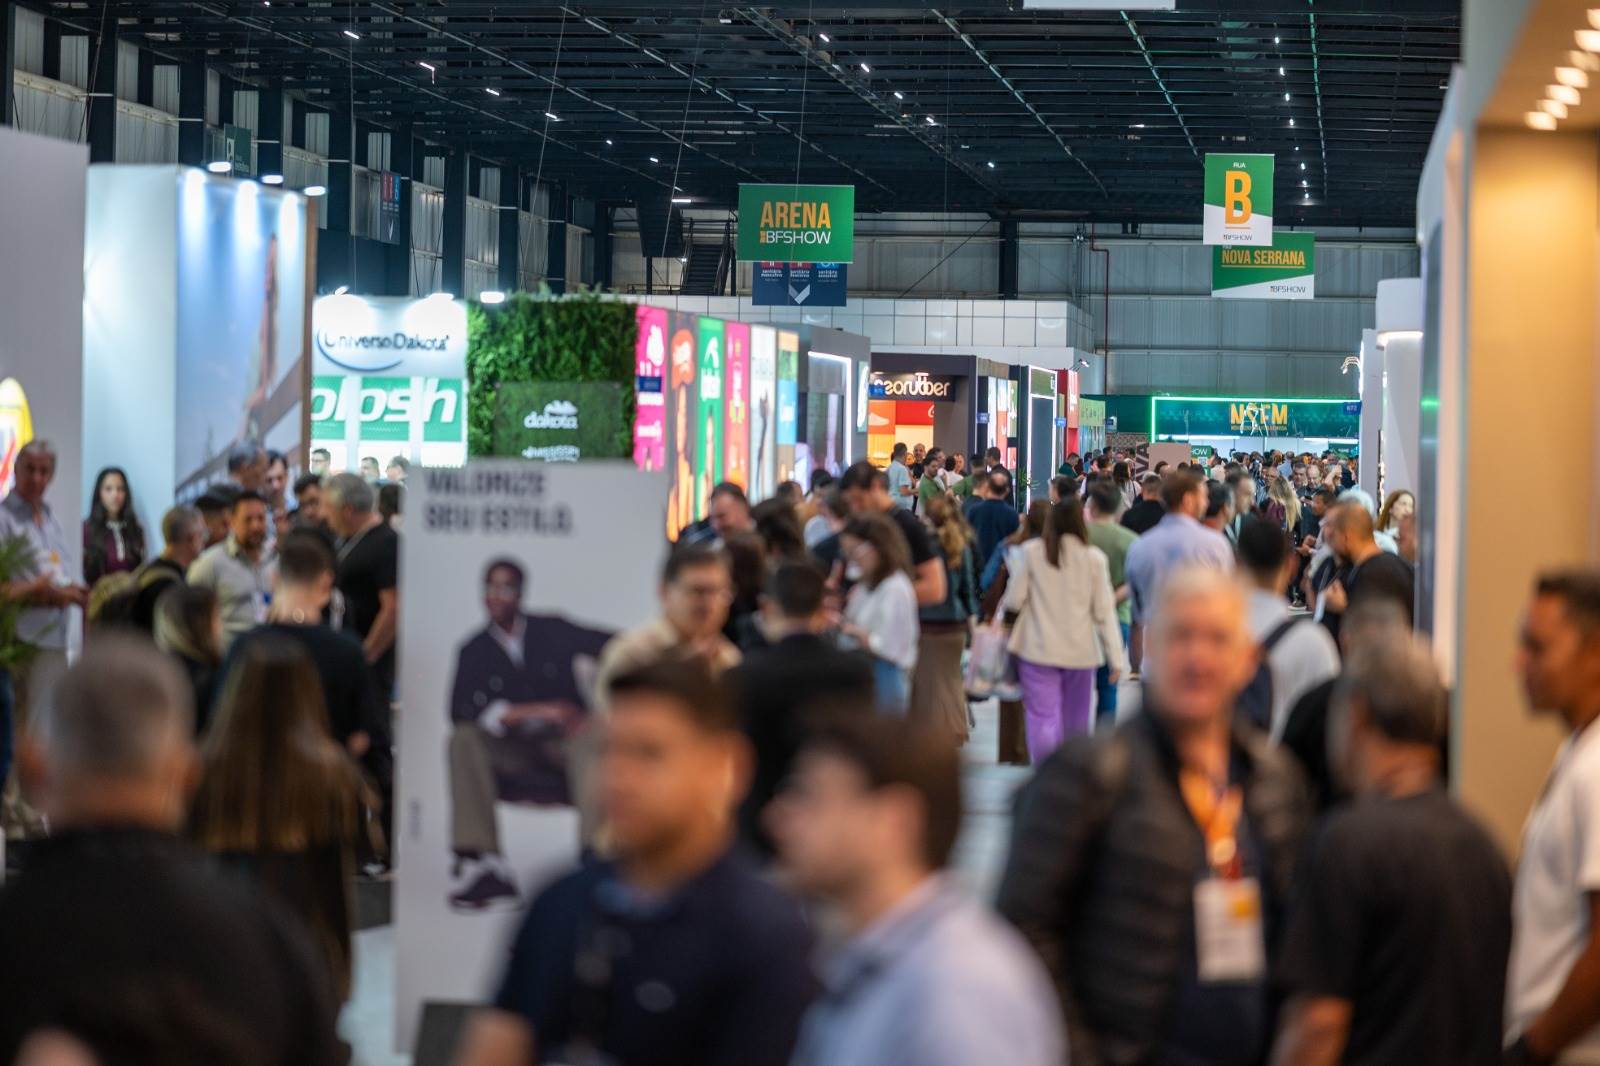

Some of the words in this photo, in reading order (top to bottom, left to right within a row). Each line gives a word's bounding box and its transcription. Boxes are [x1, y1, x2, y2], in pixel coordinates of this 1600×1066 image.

[1225, 170, 1252, 225] B
[760, 201, 831, 229] ARENA
[766, 230, 831, 244] BFSHOW
[1222, 250, 1251, 264] NOVA
[1254, 251, 1306, 266] SERRANA
[424, 504, 474, 532] SEU
